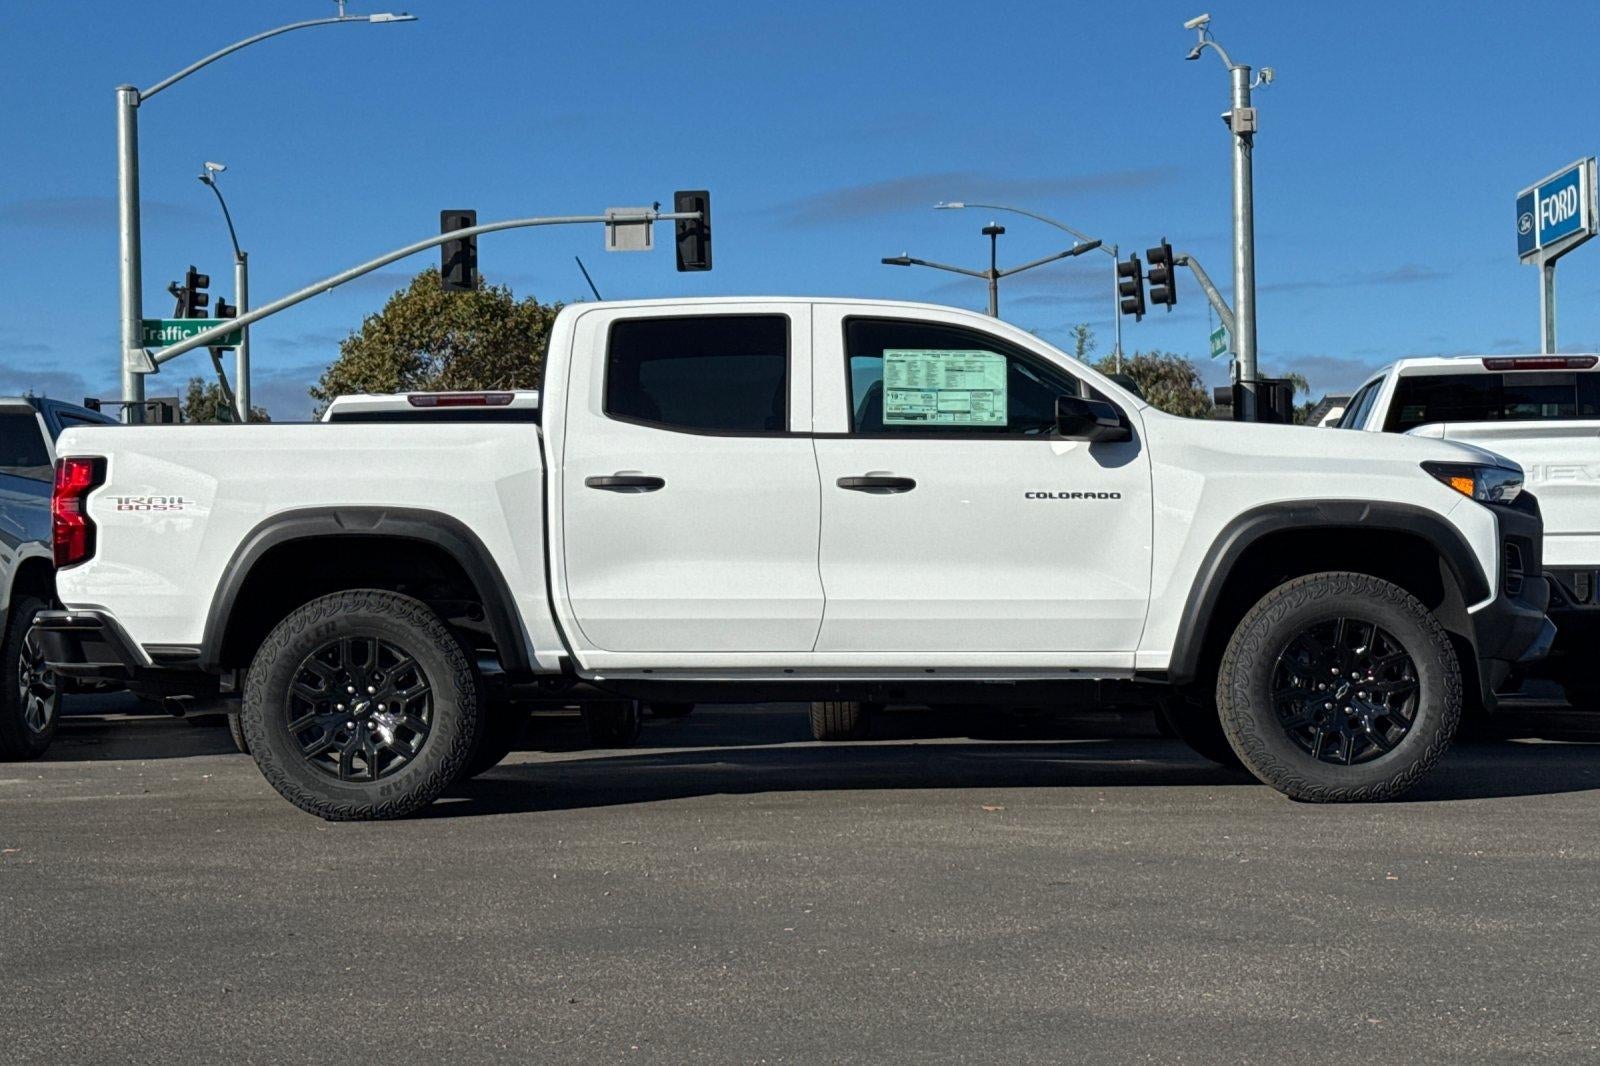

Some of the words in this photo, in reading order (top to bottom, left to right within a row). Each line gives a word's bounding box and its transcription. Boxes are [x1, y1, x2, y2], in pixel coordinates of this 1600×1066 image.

[1541, 184, 1577, 231] FORD
[142, 325, 192, 341] Traffic
[106, 496, 194, 504] TRAIL
[1025, 491, 1121, 500] COLORADO
